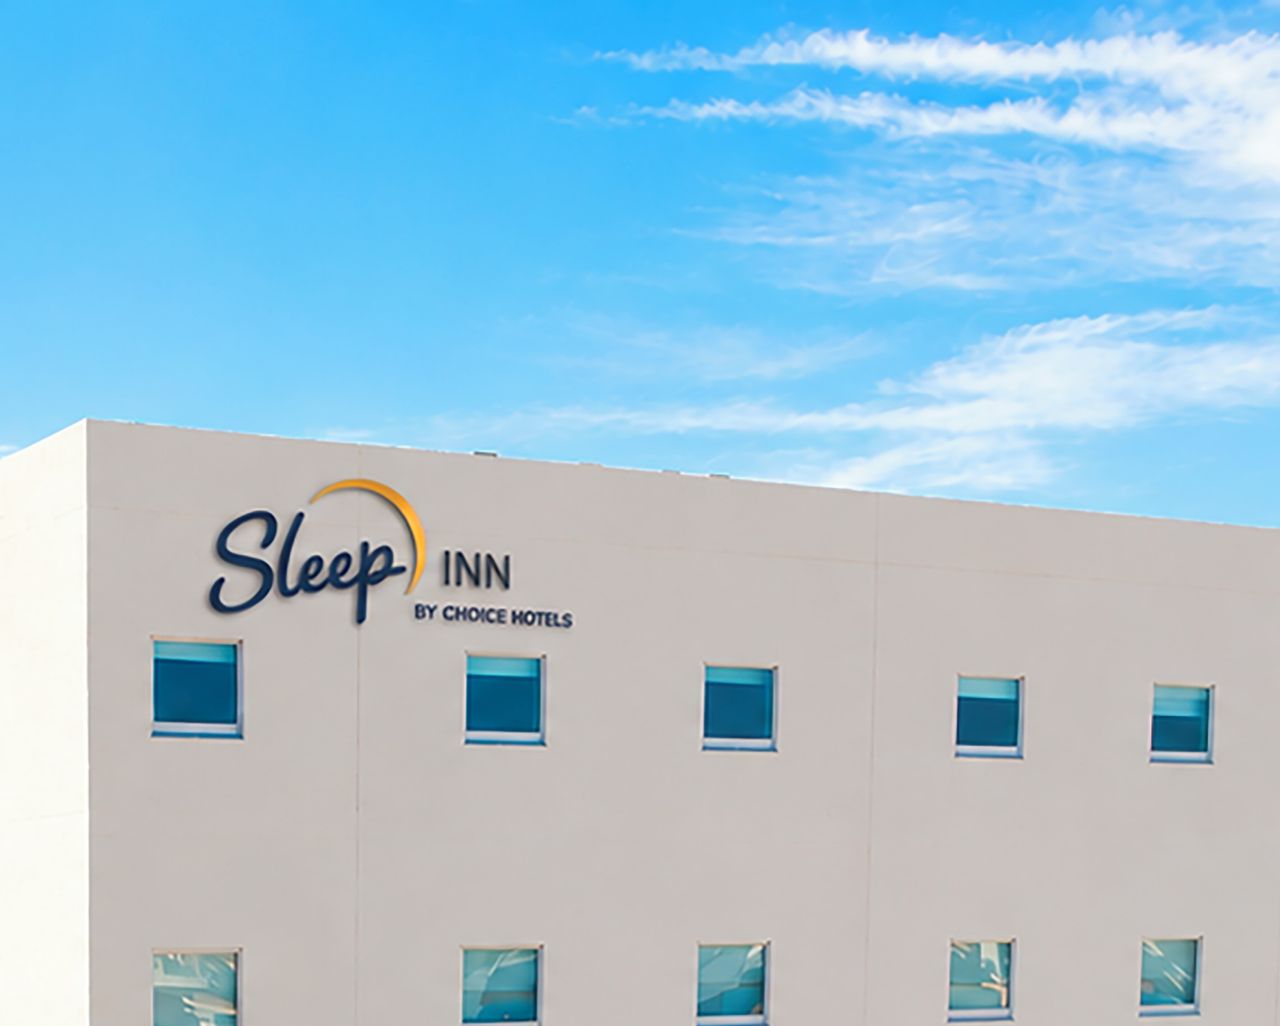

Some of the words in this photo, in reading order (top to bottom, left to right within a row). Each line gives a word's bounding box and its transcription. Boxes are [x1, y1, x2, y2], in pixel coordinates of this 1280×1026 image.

[209, 510, 406, 624] Sleep
[442, 550, 511, 590] INN
[414, 603, 438, 620] BY
[442, 605, 507, 624] CHOICE
[511, 609, 573, 629] HOTELS
